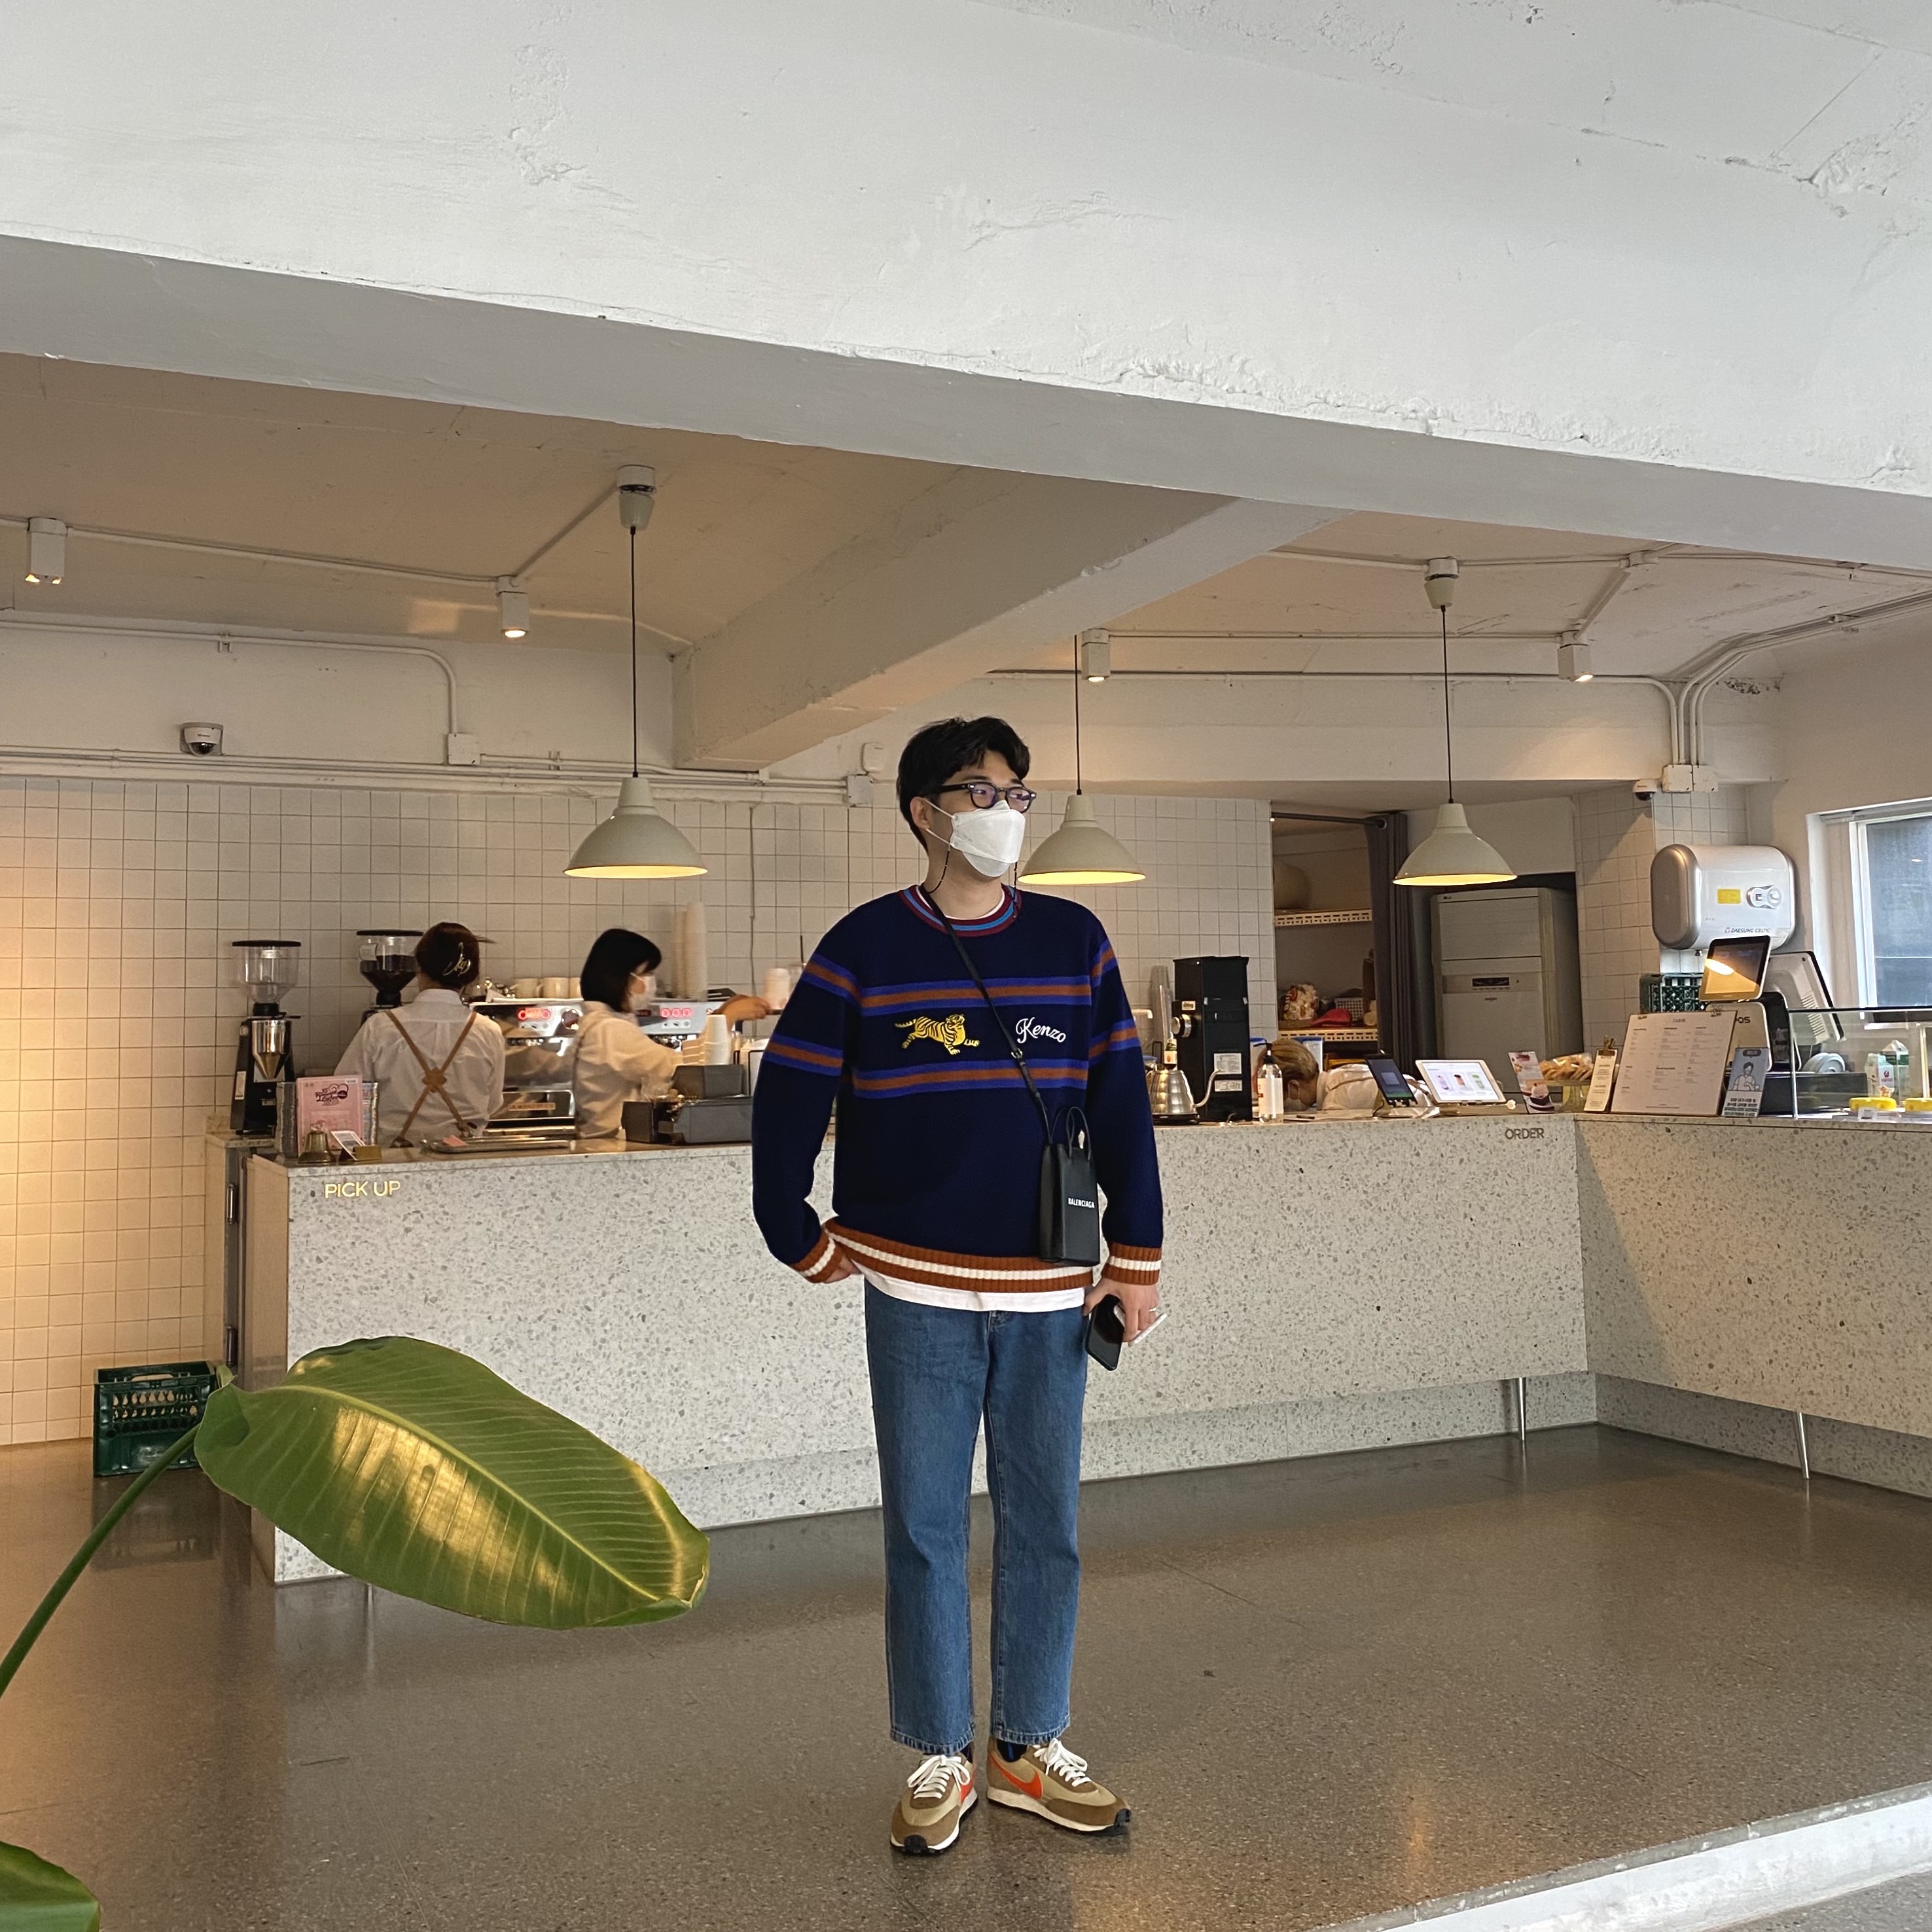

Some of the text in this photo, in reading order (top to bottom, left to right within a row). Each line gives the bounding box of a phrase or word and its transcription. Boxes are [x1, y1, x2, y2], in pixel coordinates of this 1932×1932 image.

[1015, 1016, 1066, 1044] Kenzo
[1505, 1128, 1545, 1139] ORDER
[325, 1180, 401, 1199] PICK UP
[1067, 1197, 1095, 1208] BALENCIAGA
